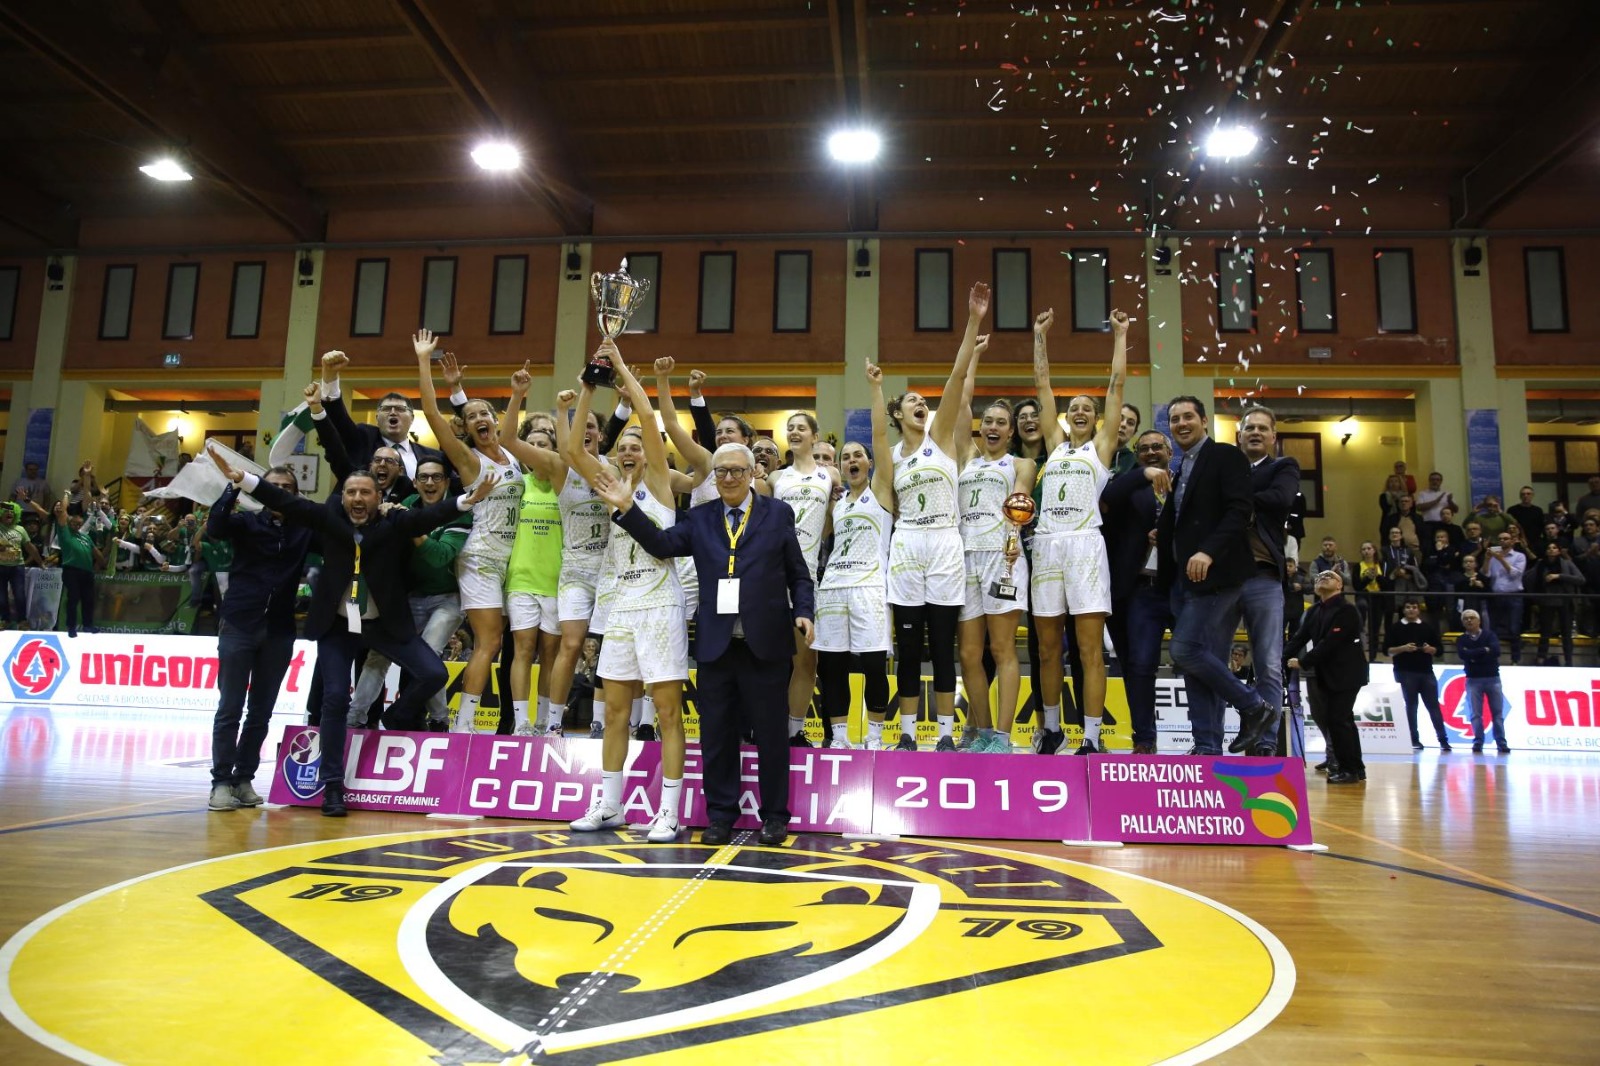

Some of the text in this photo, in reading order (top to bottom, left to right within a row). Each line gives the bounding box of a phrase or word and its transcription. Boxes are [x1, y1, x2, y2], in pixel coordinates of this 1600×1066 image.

[917, 493, 926, 512] 9
[1058, 482, 1067, 502] 6
[505, 506, 516, 527] 30
[590, 523, 602, 539] 12
[343, 734, 450, 794] LBF
[1100, 762, 1204, 783] FEDERAZIONE
[393, 796, 440, 806] FEMMINILE
[894, 776, 1069, 813] 2019
[1156, 788, 1226, 810] ITALIANA
[1120, 814, 1245, 837] PALLACANESTRO
[289, 882, 403, 902] 19
[961, 916, 1084, 941] 79
